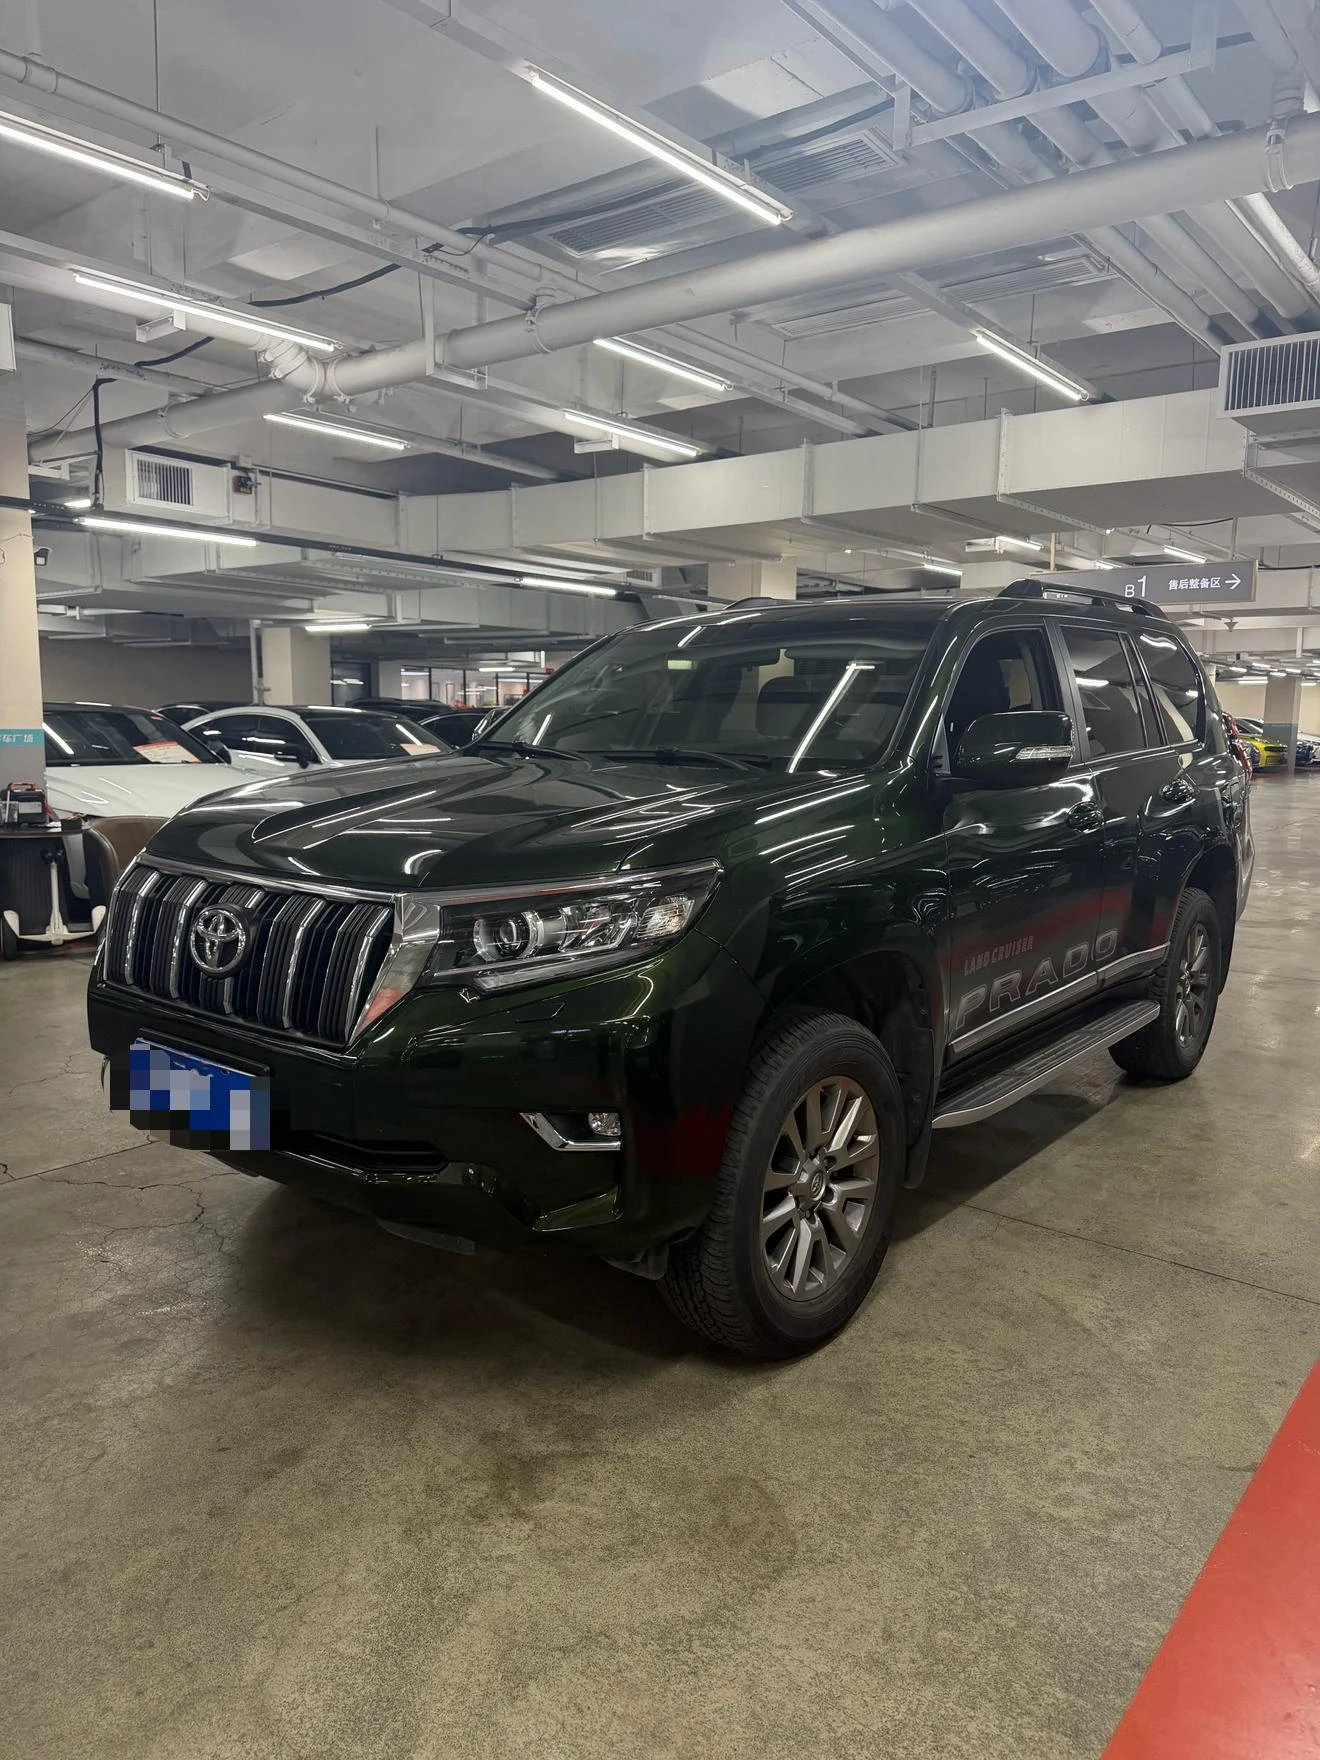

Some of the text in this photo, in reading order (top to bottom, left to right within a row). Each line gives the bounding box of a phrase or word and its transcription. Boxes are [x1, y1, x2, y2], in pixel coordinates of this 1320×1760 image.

[1124, 575, 1147, 598] B1
[1168, 577, 1221, 591] 售后整备区
[964, 935, 1034, 976] LAND CRUISER
[955, 928, 1119, 1030] PRADO
